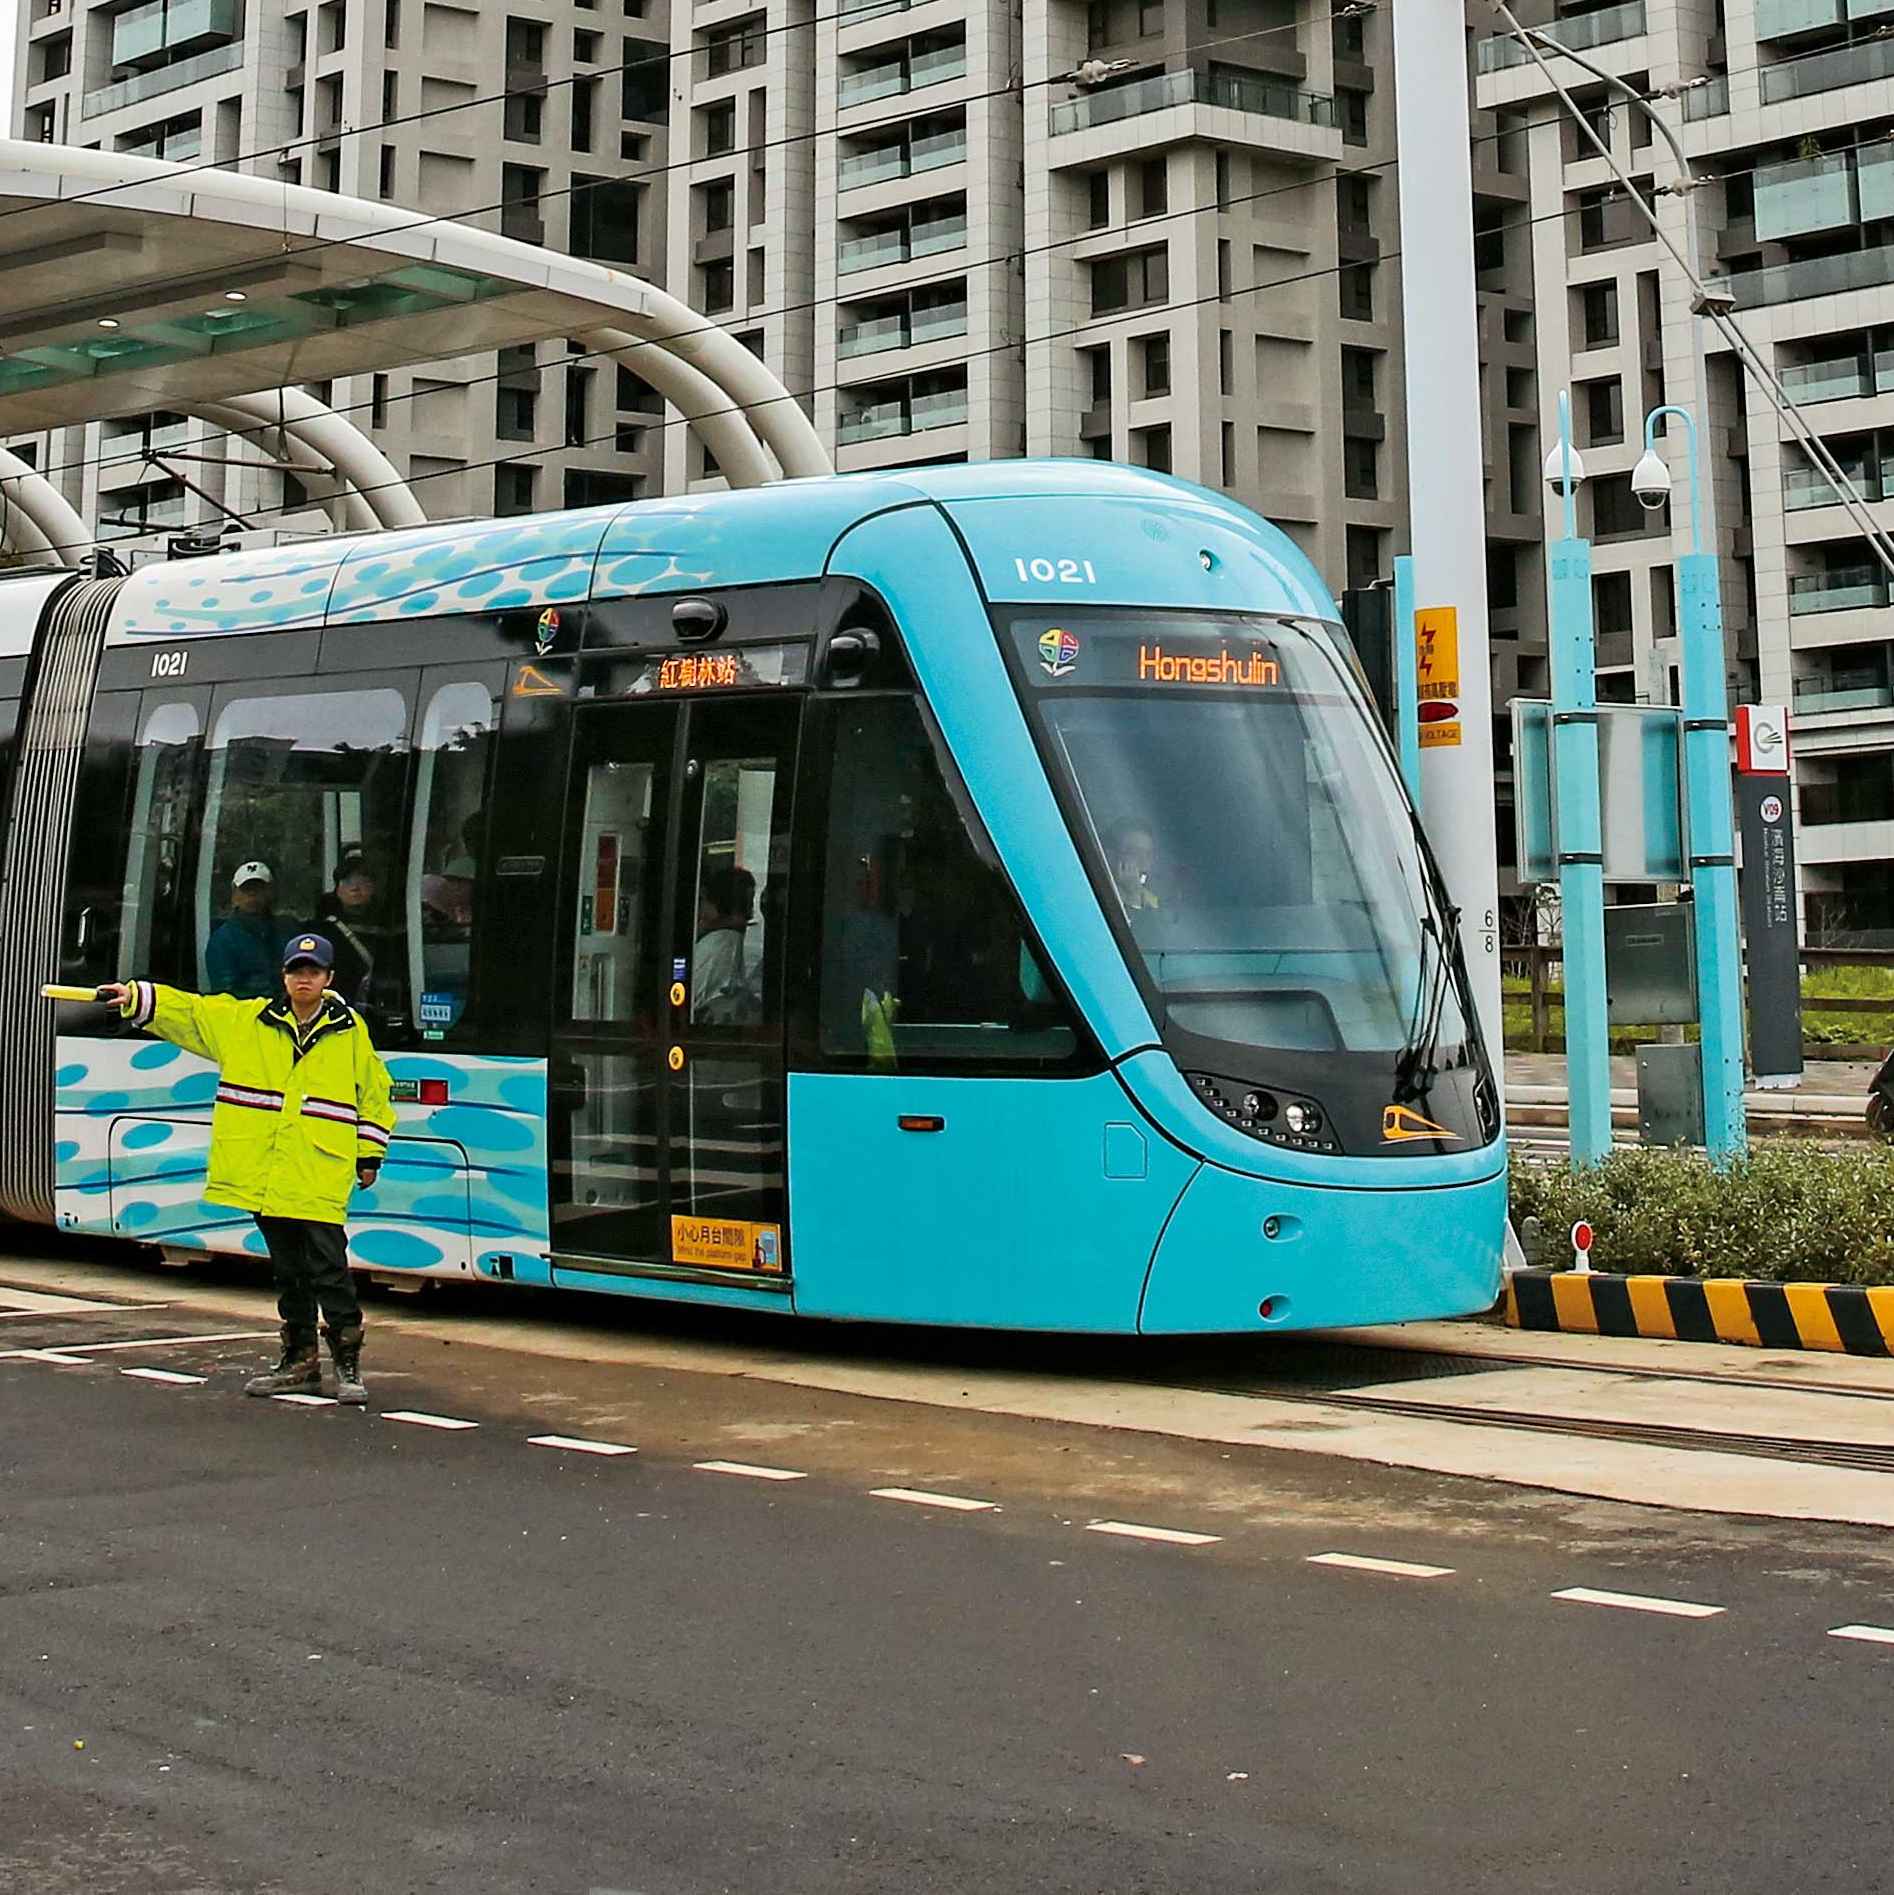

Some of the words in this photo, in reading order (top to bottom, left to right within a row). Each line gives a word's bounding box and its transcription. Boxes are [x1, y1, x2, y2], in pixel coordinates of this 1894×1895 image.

[1014, 557, 1097, 585] 1021
[150, 651, 189, 678] 1021
[659, 655, 738, 690] 紅樹林站
[1139, 645, 1279, 686] Hongshulin
[1763, 801, 1779, 816] V09
[1484, 909, 1494, 928] 6
[1484, 934, 1494, 954] 8
